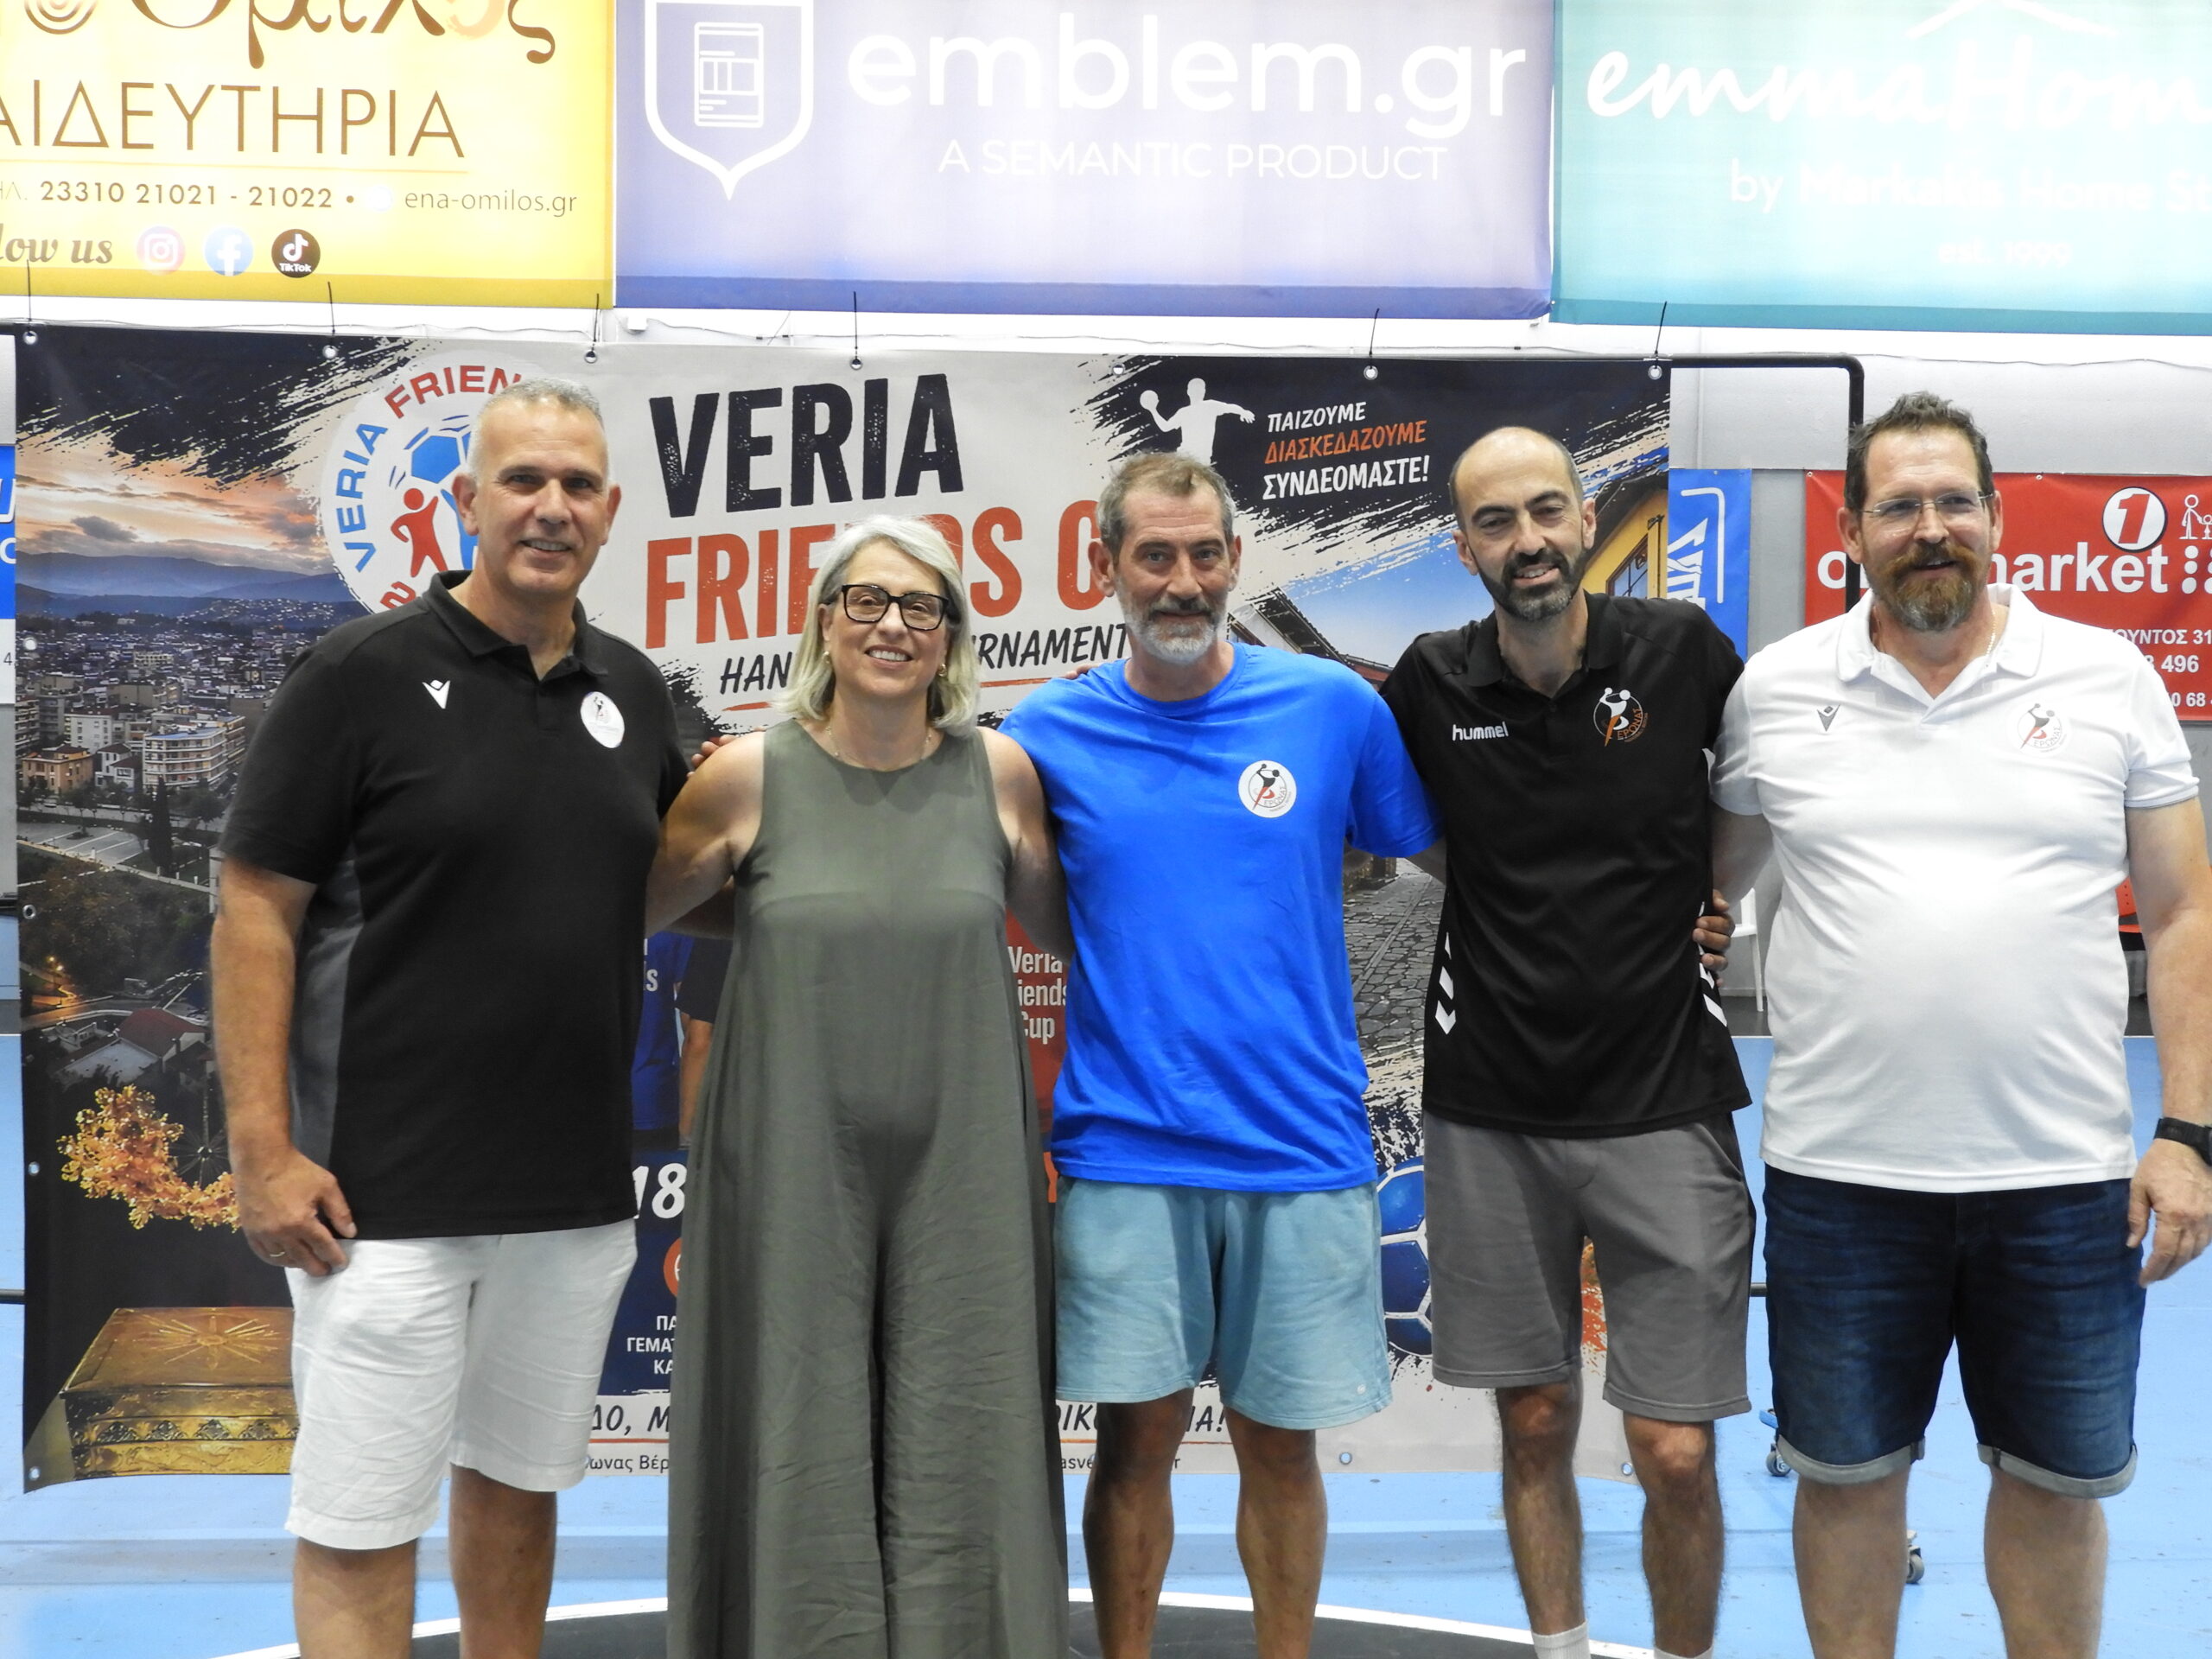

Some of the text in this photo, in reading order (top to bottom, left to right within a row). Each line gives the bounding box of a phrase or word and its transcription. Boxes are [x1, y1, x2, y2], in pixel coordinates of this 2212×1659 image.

[847, 12, 1527, 140] emblem.gr
[938, 140, 1447, 181] A SEMANTIC PRODUCT
[41, 181, 124, 202] 23310
[136, 183, 215, 205] 21021
[248, 186, 332, 208] 21022
[404, 188, 577, 219] ena-omilos.gr
[1729, 158, 1784, 213] by
[70, 238, 113, 264] us
[278, 262, 312, 273] TikTok
[1267, 401, 1368, 434] ΠΑΙΖΟΥΜΕ
[649, 373, 964, 518] VERIA
[1263, 420, 1428, 465] ΔΙΑΣΚΕΔΑΖΟΥΜΕ
[335, 365, 522, 574] VERIA FRIEN
[1262, 454, 1431, 501] ΣΥΝΔΕΟΜΑΣΤΕ!
[2117, 493, 2151, 545] 1
[2161, 654, 2200, 673] 496
[2185, 692, 2207, 708] 68
[1452, 721, 1510, 741] hummel
[1007, 945, 1064, 974] Veria
